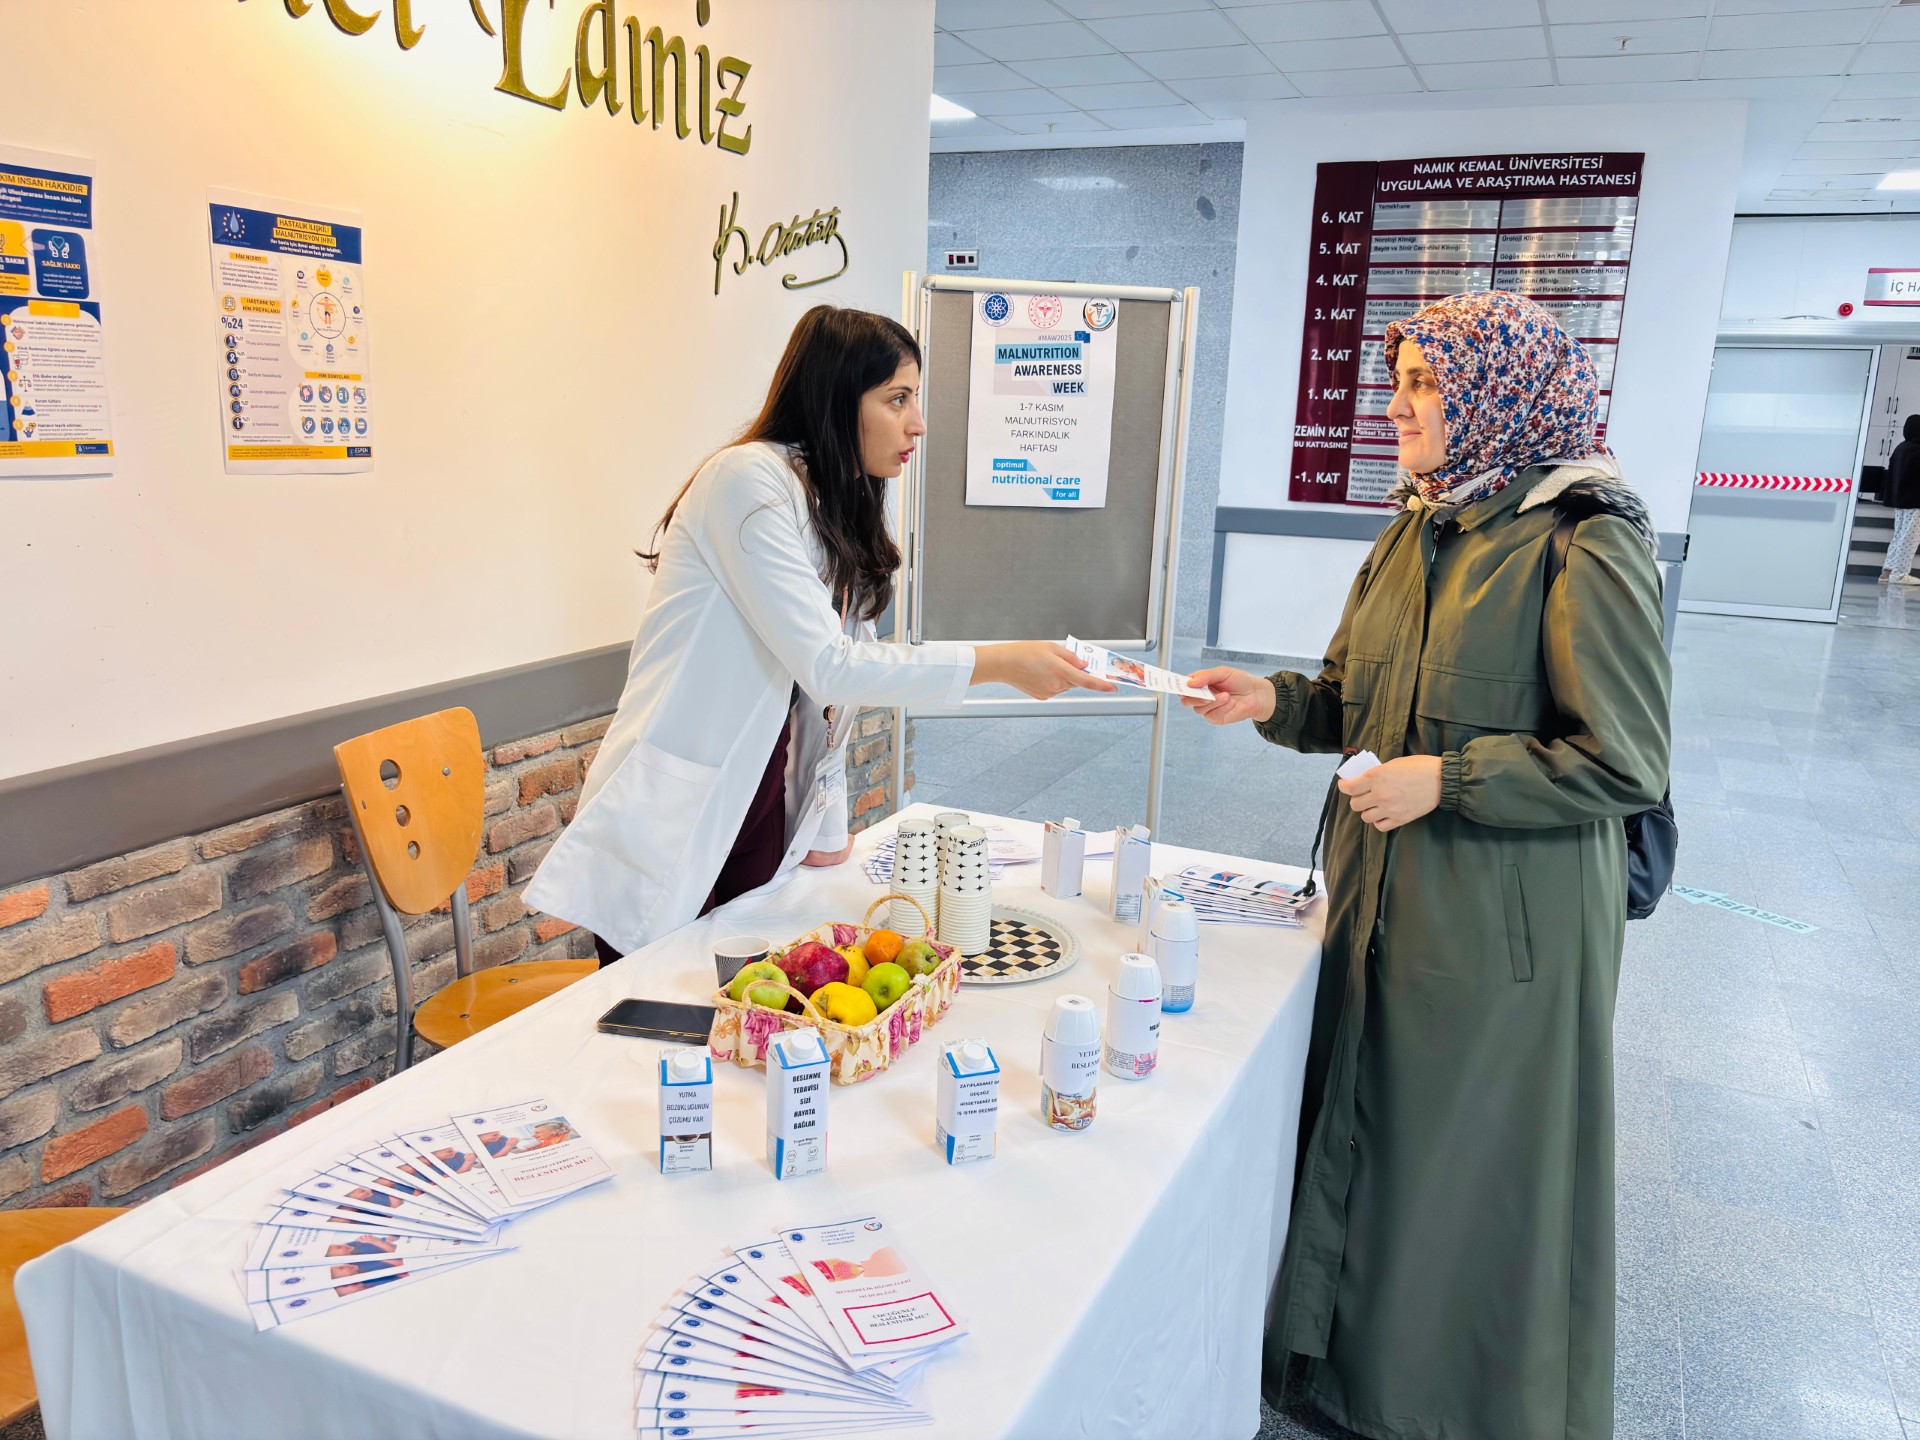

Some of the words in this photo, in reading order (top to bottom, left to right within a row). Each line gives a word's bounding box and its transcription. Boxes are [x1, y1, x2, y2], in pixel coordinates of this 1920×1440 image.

[1414, 163, 1455, 174] NAMIK
[1459, 161, 1504, 172] KEMAL
[1509, 156, 1603, 170] ÜNİVERSİTESİ
[46, 181, 83, 193] HAKKIDIR
[1381, 178, 1452, 192] UYGULAMA
[1456, 178, 1474, 188] VE
[1476, 175, 1555, 190] ARAŞTIRMA
[1560, 172, 1636, 185] HASTANESİ
[1321, 212, 1333, 224] 6.
[1338, 212, 1364, 223] KAT
[1320, 243, 1331, 254] 5.
[1336, 243, 1361, 254] KAT
[1316, 275, 1328, 286] 4.
[1333, 275, 1358, 286] KAT
[1891, 279, 1904, 294] İÇ
[1314, 309, 1326, 320] 3.
[1331, 309, 1356, 320] KAT
[221, 317, 243, 329] %24
[998, 348, 1079, 360] MALNUTRITION
[1311, 349, 1322, 360] 2.
[1327, 349, 1352, 361] KAT
[1014, 364, 1082, 376] AWARENESS
[1053, 382, 1084, 394] WEEK
[1308, 389, 1318, 400] 1.
[1323, 389, 1348, 400] KAT
[1020, 403, 1033, 411] 1-7
[1036, 404, 1064, 412] KASIM
[1005, 416, 1078, 426] MALNUTRİSYON
[1011, 430, 1070, 440] FARKINDALIK
[1295, 424, 1328, 437] ZEMİN
[1329, 427, 1350, 438] KAT
[1020, 444, 1058, 452] HAFTASI
[992, 474, 1052, 485] nutritional
[1056, 477, 1081, 485] care
[1295, 472, 1311, 483] -1.
[1316, 472, 1341, 484] KAT
[792, 1072, 822, 1082] BESLENME
[800, 1097, 811, 1105] SİZİ
[794, 1108, 816, 1118] HAYATA
[794, 1120, 816, 1130] BAĞLAR
